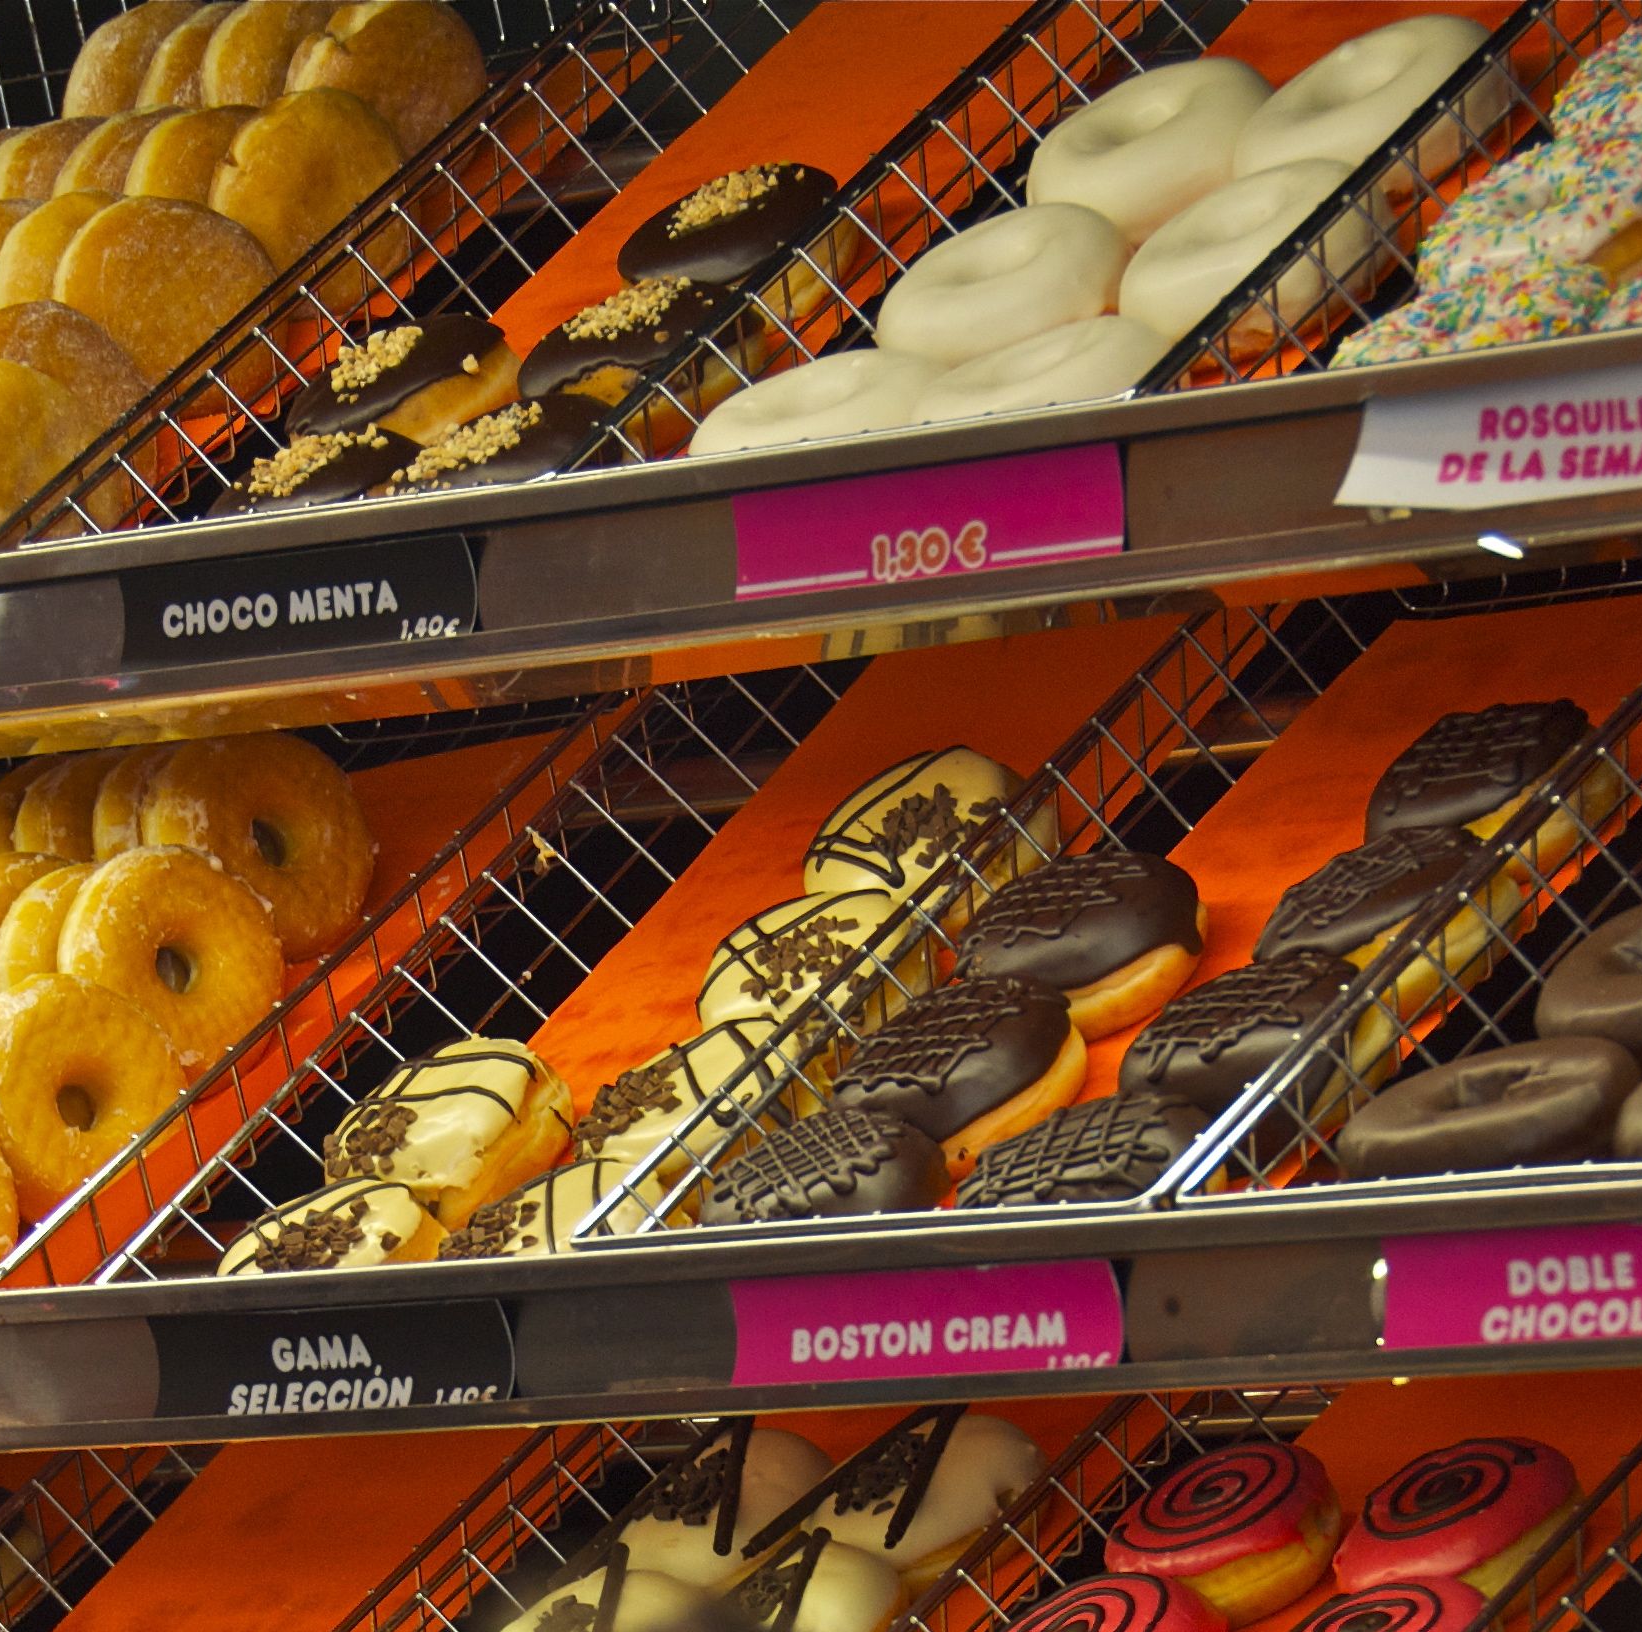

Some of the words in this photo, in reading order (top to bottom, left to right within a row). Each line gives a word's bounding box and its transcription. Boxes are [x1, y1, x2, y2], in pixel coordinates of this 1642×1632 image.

[1437, 452, 1488, 483] DE
[1498, 449, 1544, 482] LA
[163, 593, 278, 638] CHOCO
[289, 580, 398, 624] MENTA
[1506, 1252, 1636, 1298] DOBLE
[271, 1334, 372, 1372] GAMA
[791, 1320, 932, 1363] BOSTON
[943, 1311, 1067, 1353] CREAM
[228, 1364, 413, 1416] SELECCIÓN
